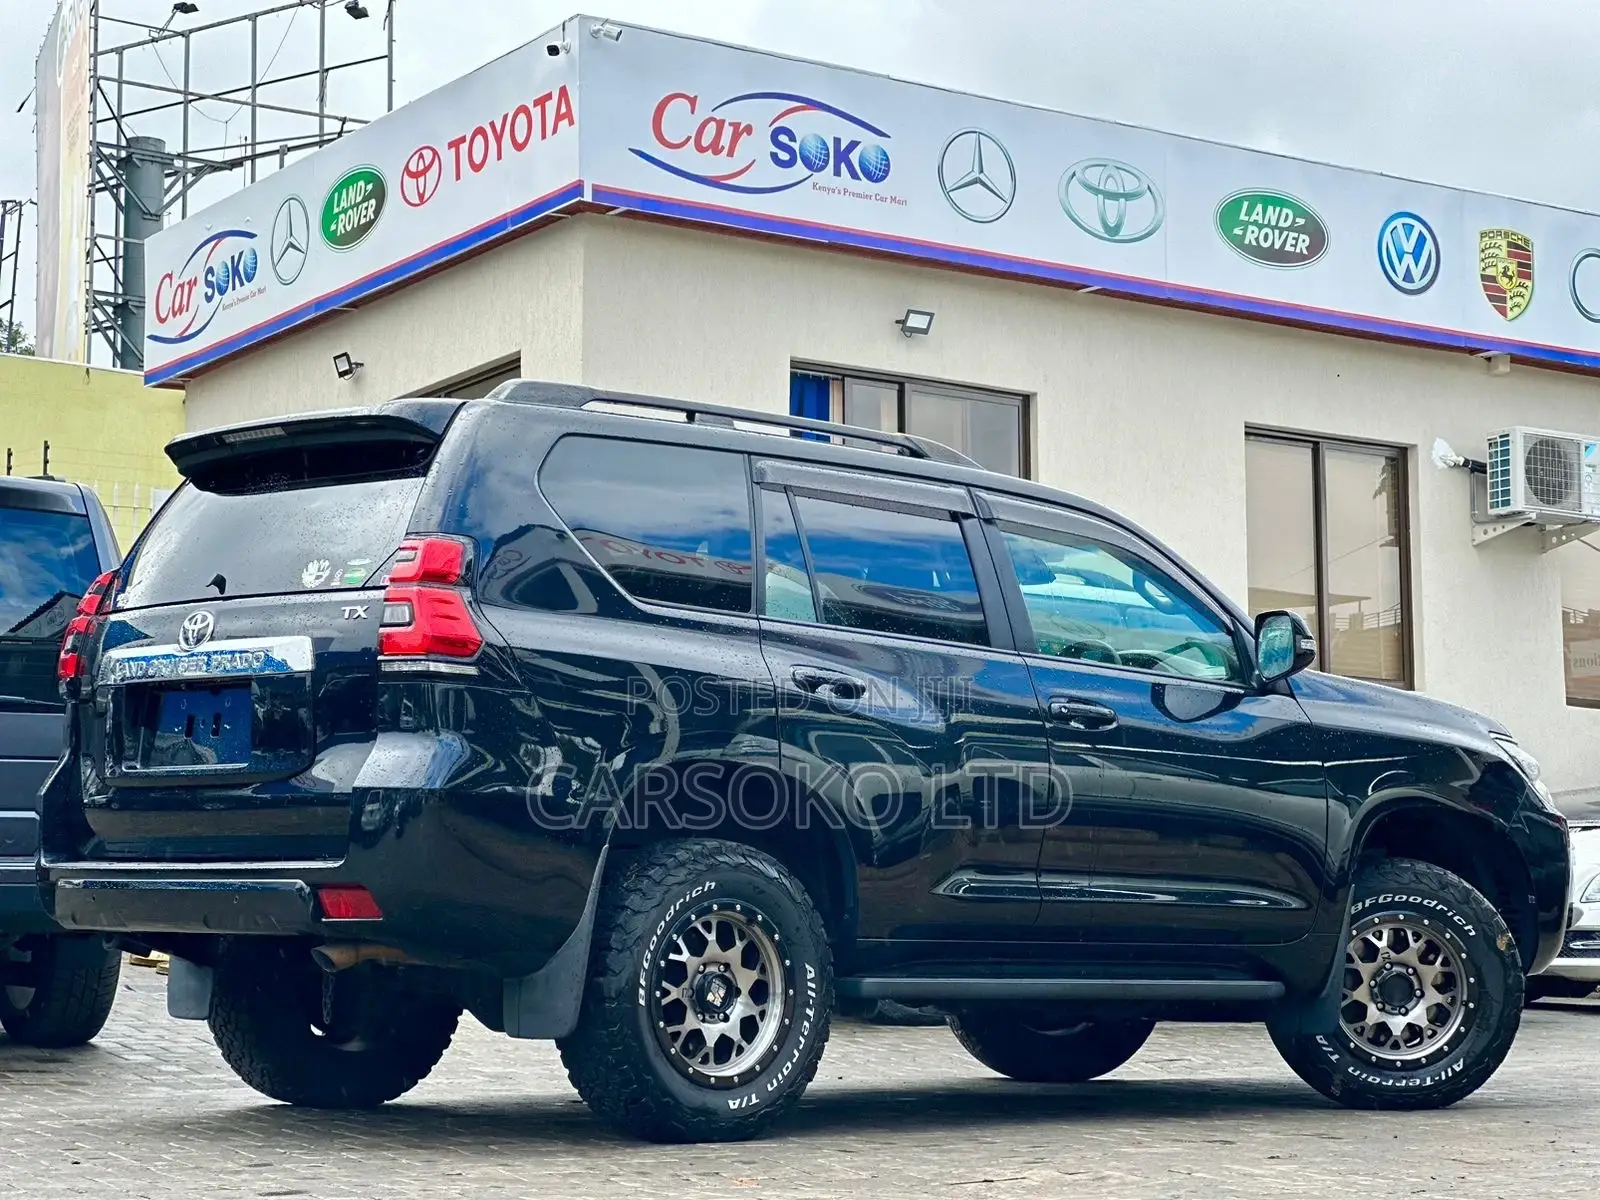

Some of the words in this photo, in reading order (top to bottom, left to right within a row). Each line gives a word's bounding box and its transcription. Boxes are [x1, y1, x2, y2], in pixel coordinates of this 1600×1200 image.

[447, 84, 575, 182] TOYOTA
[652, 92, 753, 158] Car
[769, 125, 891, 183] SOKO
[332, 179, 365, 214] LAND
[812, 182, 842, 196] Kenya's
[843, 187, 873, 201] Premier
[874, 193, 889, 203] Car
[889, 195, 908, 206] Mart
[336, 198, 376, 236] ROVER
[1239, 201, 1295, 228] LAND
[1245, 224, 1310, 255] ROVER
[1480, 229, 1531, 249] PORSCHE
[204, 247, 258, 304] SOKO
[155, 270, 198, 324] Car
[341, 605, 370, 619] TX
[1351, 893, 1476, 937] BFGoodrich
[638, 880, 716, 1007] BFGoodrich
[766, 963, 816, 1092] All-Terrain
[1315, 1034, 1341, 1063] T/A
[1347, 1058, 1465, 1087] All-Terrain
[728, 1092, 760, 1110] T/A
